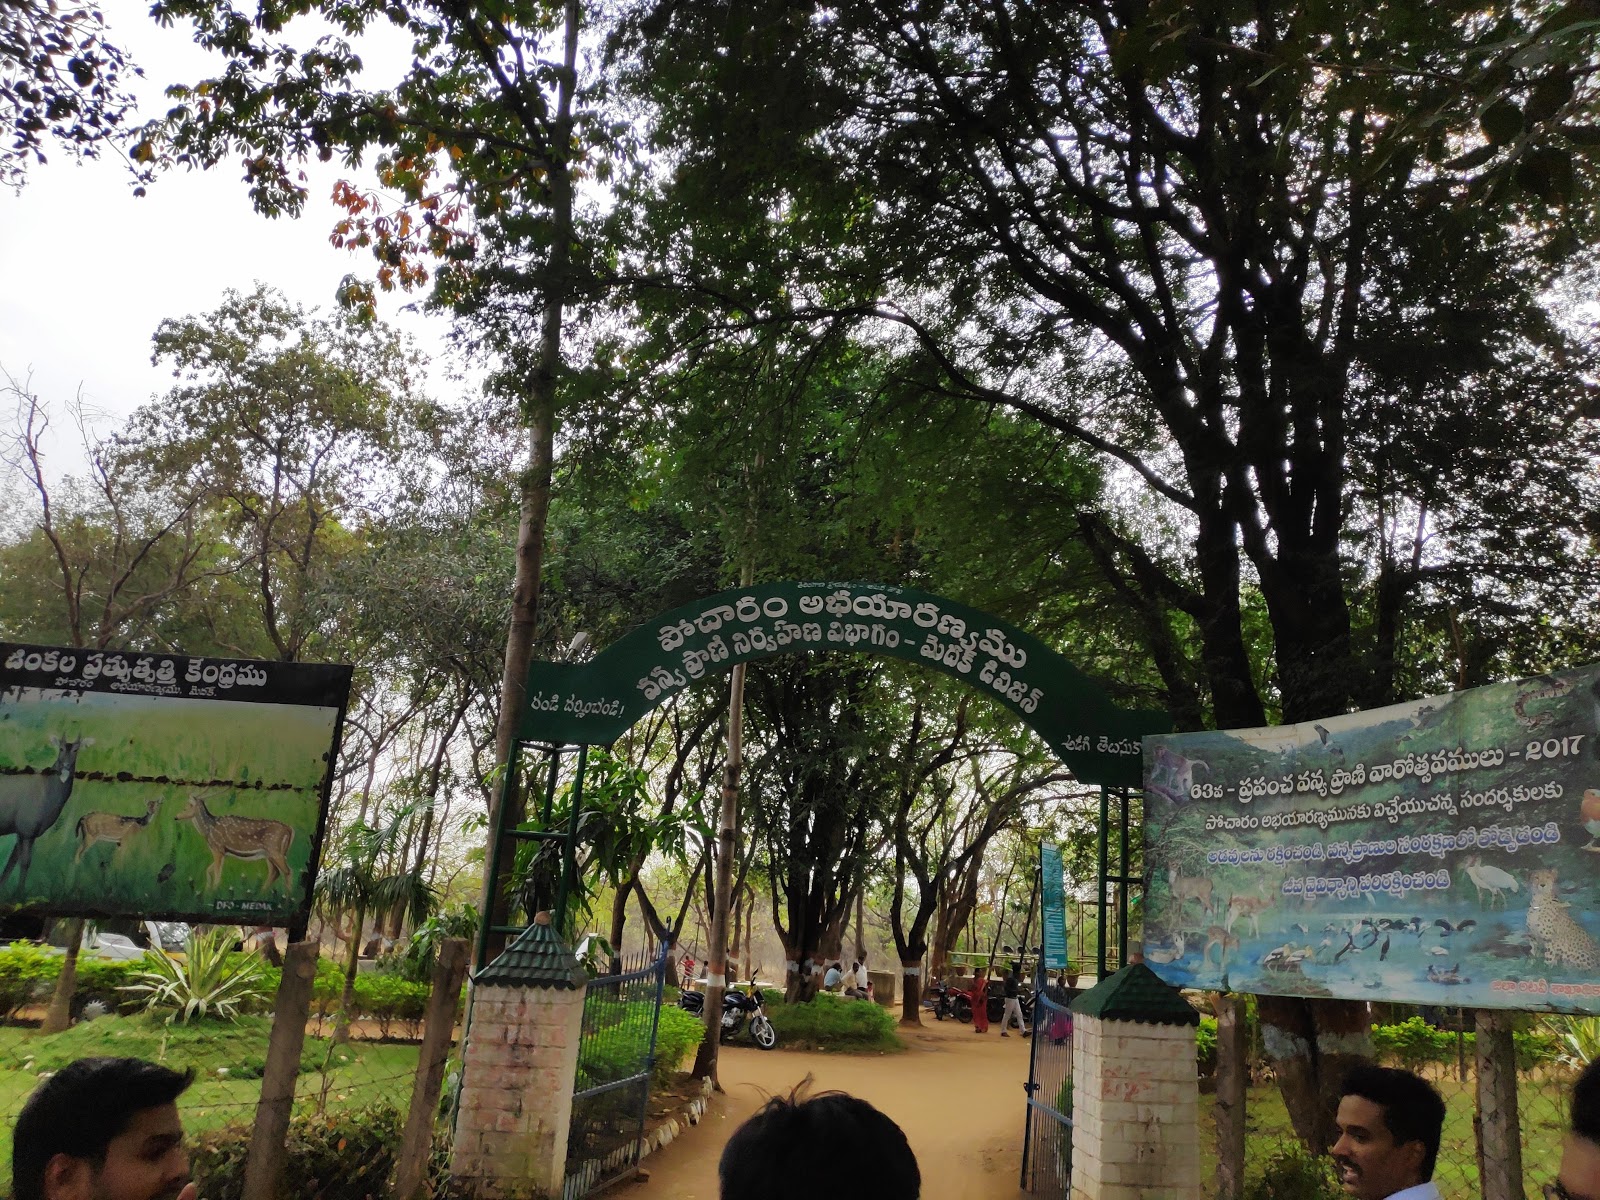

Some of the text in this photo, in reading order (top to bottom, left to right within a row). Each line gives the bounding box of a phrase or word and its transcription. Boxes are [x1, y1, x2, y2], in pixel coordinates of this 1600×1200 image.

[657, 590, 1026, 669] పోచారం అభయారణ్యము
[54, 676, 94, 688] పోచారం
[185, 658, 267, 689] కేంద్రము
[636, 666, 687, 701] వన్య
[681, 635, 729, 680] ప్రాణి
[732, 620, 822, 655] నిర్వహణ
[827, 621, 900, 648] విభాగం
[920, 633, 977, 674] మెదక్
[979, 659, 1044, 714] డివిజన్
[531, 690, 560, 711] రండి
[1190, 783, 1224, 799] 63వ
[1238, 773, 1294, 804] ప్రపంచ
[1296, 768, 1327, 797] వన్య
[1329, 763, 1366, 795] ప్రాణి
[1526, 734, 1585, 761] 2017
[1205, 814, 1258, 831] పోచారం
[1261, 803, 1371, 830] అభయారణ్యమునకు
[1460, 781, 1564, 813] సందర్శకులకు
